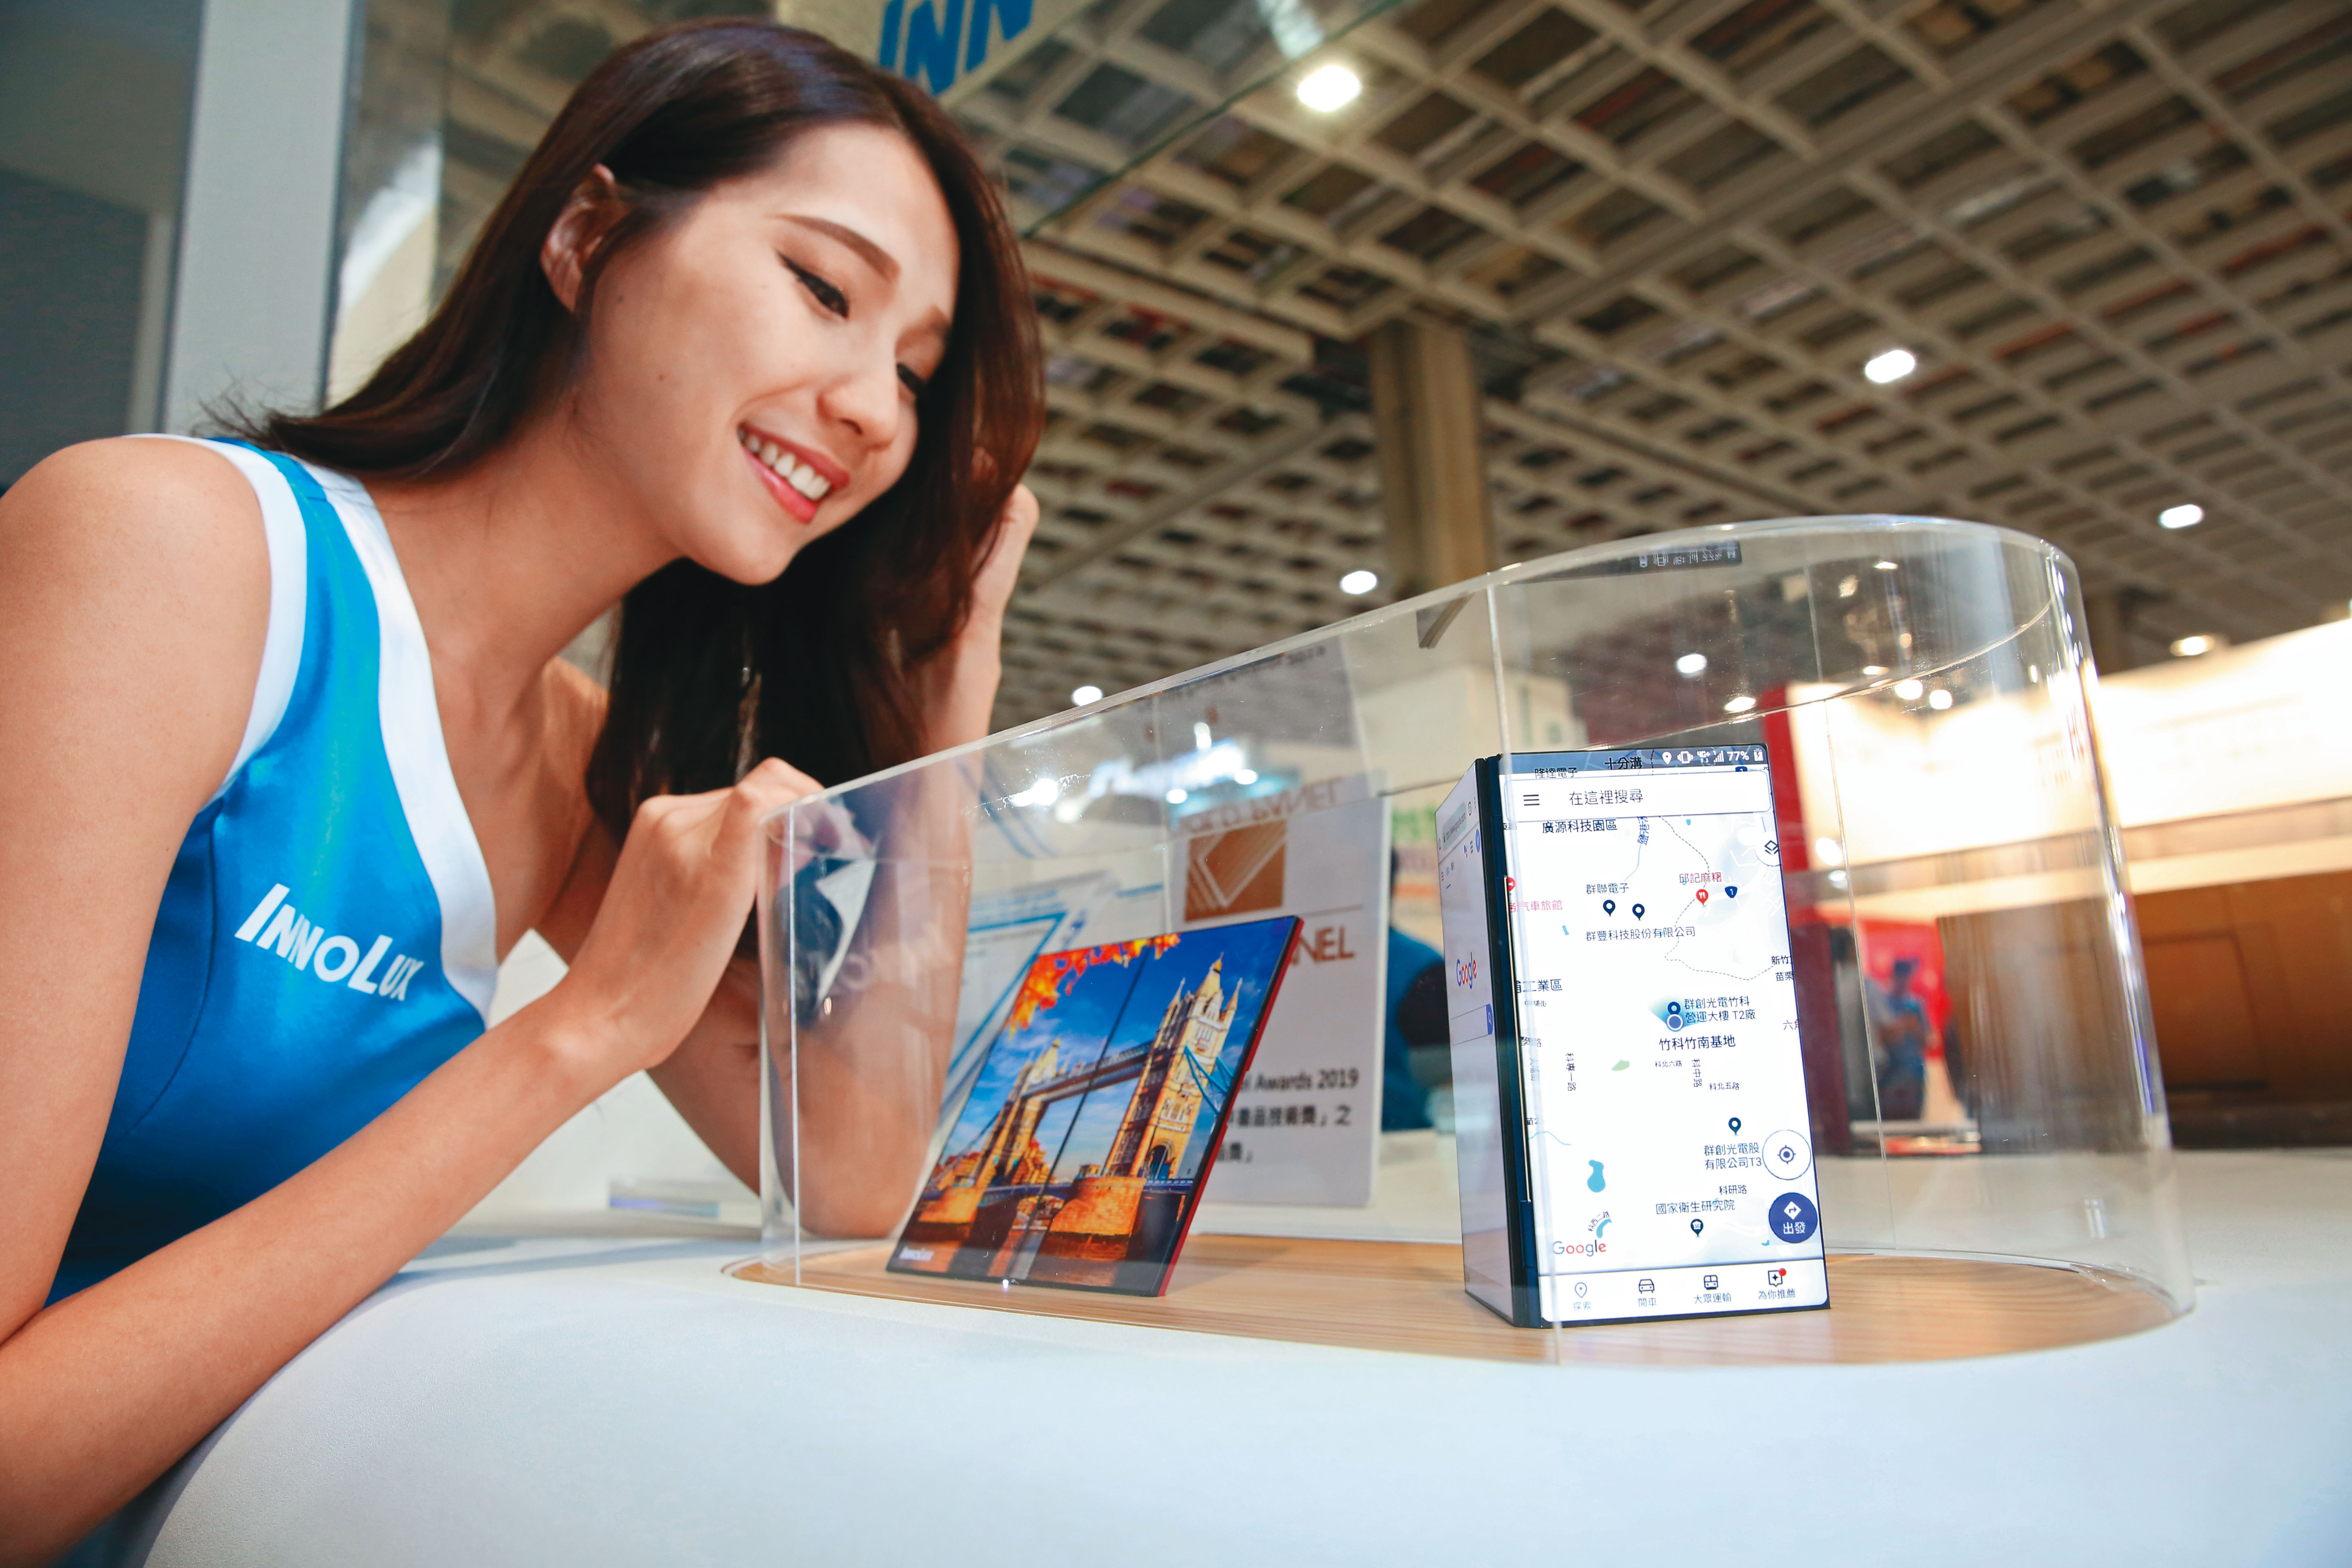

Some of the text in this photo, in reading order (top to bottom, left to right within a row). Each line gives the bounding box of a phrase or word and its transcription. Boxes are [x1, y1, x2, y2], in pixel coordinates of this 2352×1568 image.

[1727, 751, 1750, 761] 77%
[1604, 757, 1642, 770] 十分溝
[1535, 767, 1578, 779] 隆達電子
[1569, 789, 1643, 806] 在這裡搜尋
[1543, 819, 1617, 833] 廣源科技園區
[1679, 872, 1722, 884] 邱記麻糬
[1586, 883, 1629, 894] 群聯電子
[1586, 927, 1695, 942] 群豐科技股份有限公司
[234, 883, 424, 1001] INNOLUX
[1771, 956, 1793, 965] 新竹
[1456, 952, 1477, 989] Google
[1684, 996, 1750, 1010] 群創光電竹科
[1686, 1009, 1756, 1023] 營運大樓 T2廠
[1659, 1034, 1736, 1051] 竹科竹南基地
[1316, 1067, 1360, 1089] 2019
[1565, 1053, 1576, 1091] 科專一路
[1691, 1059, 1702, 1087] 科中路
[1709, 1082, 1740, 1090] 科北五路
[1704, 1143, 1760, 1156] 群創光電股
[1704, 1157, 1762, 1170] 有限公司T3
[1719, 1185, 1747, 1195] 科研路
[1656, 1199, 1735, 1215] 國家衛生研究院
[1783, 1221, 1806, 1234] 出發
[1552, 1239, 1606, 1257] Google
[1694, 1292, 1732, 1304] 大眾運輸
[1758, 1288, 1795, 1300] 為你推薦
